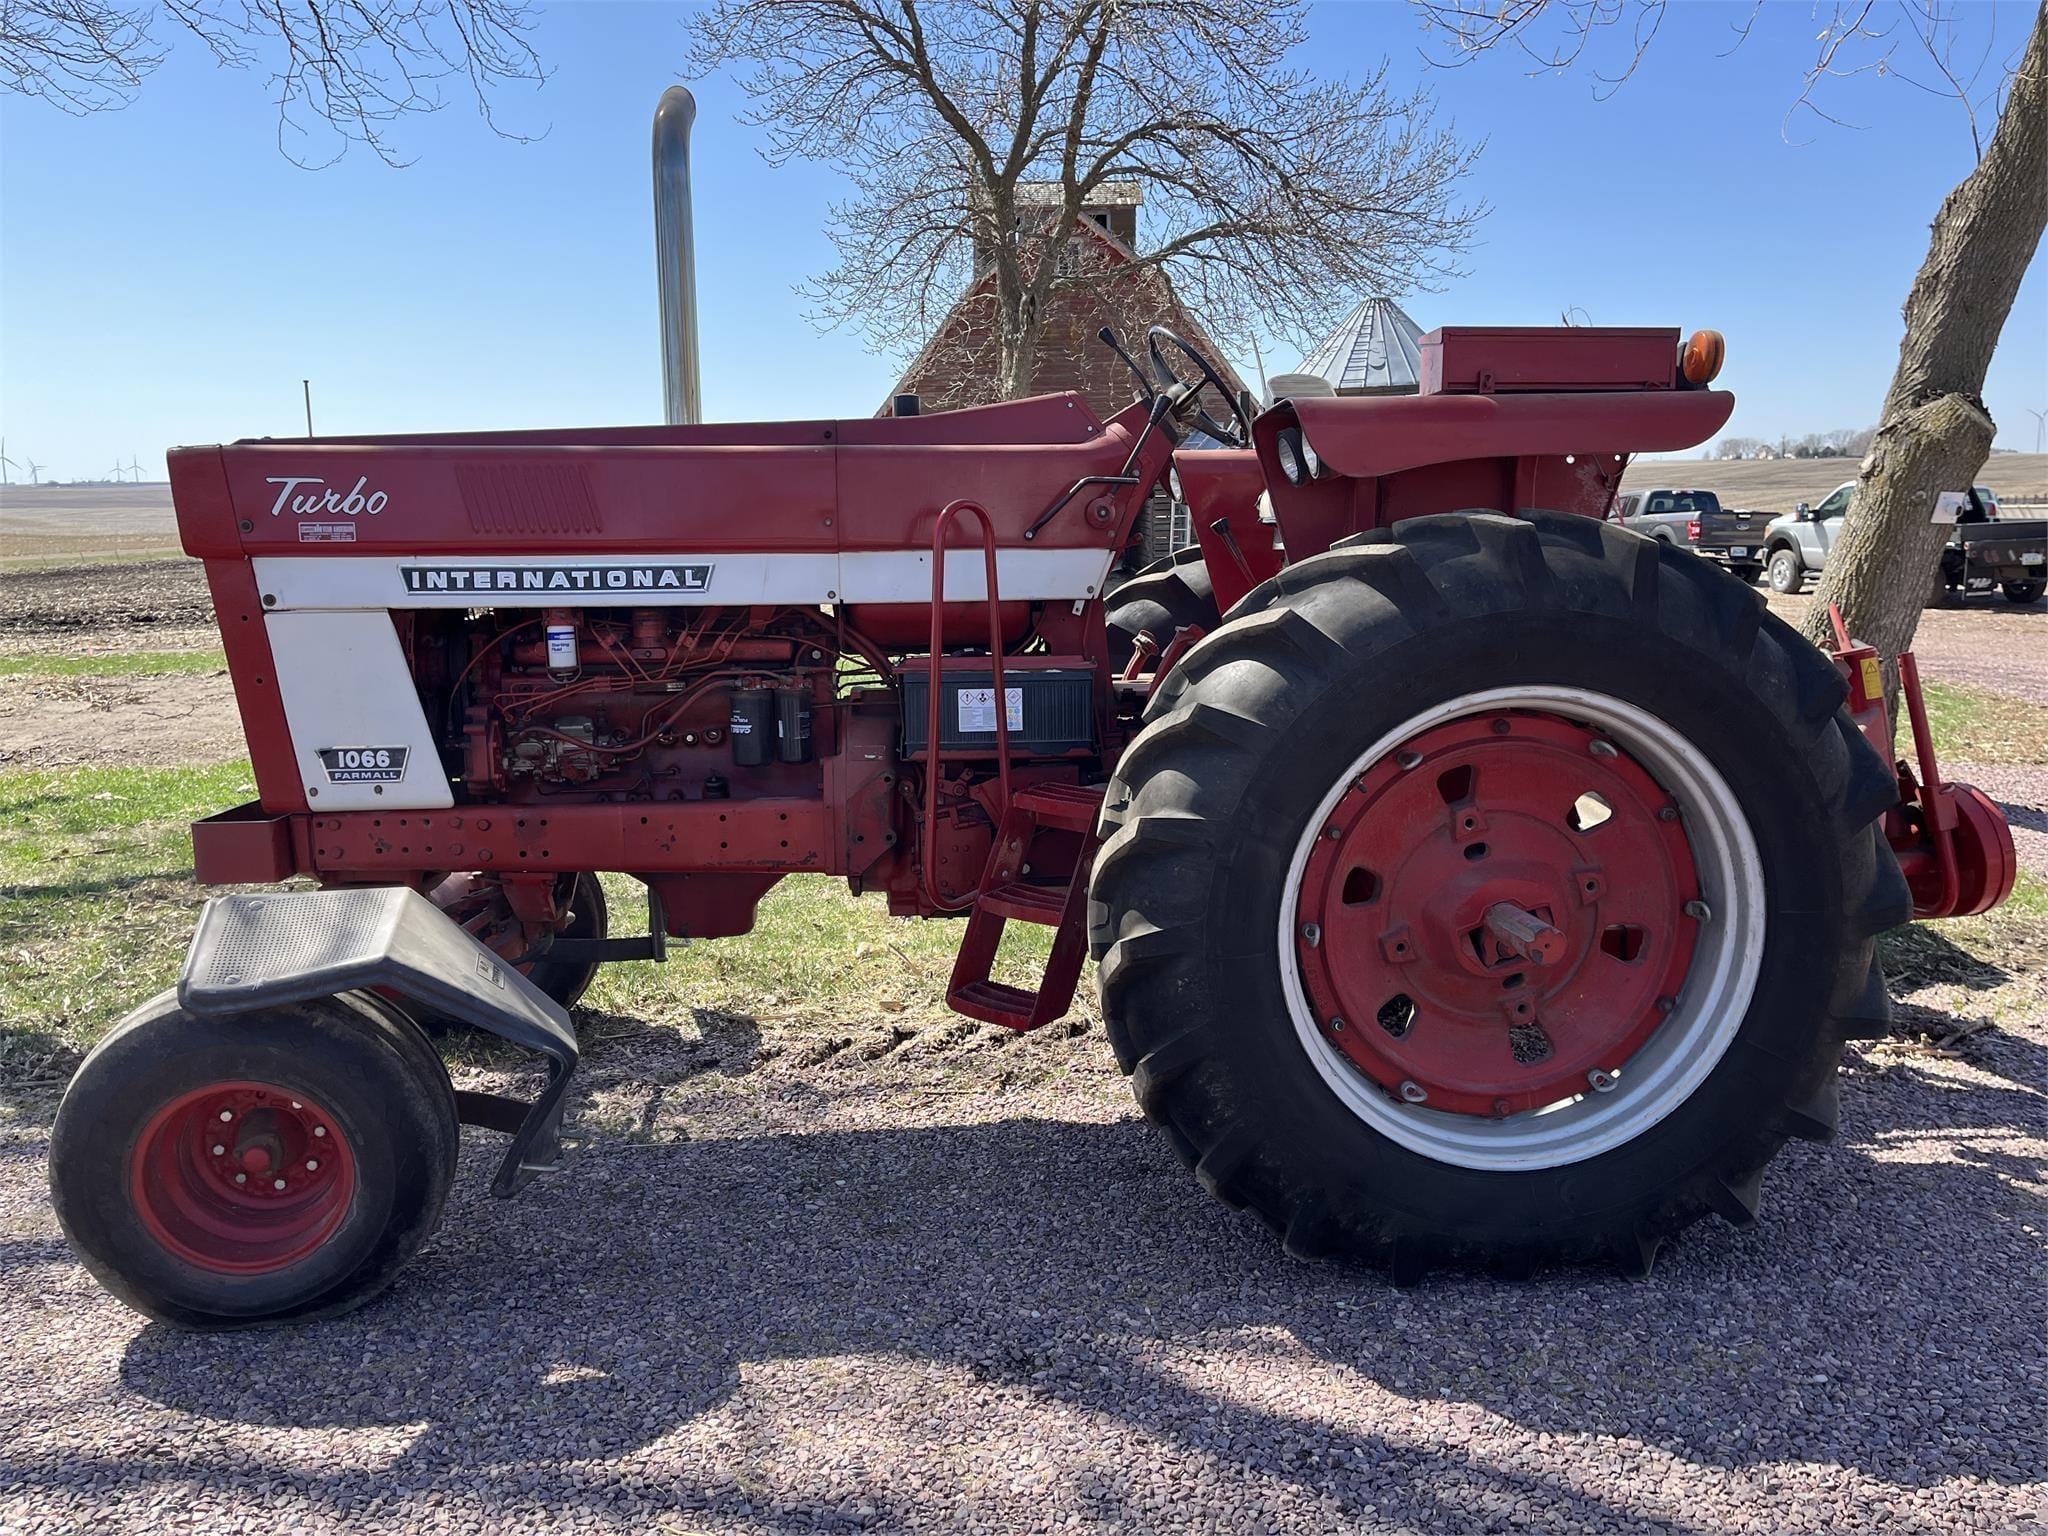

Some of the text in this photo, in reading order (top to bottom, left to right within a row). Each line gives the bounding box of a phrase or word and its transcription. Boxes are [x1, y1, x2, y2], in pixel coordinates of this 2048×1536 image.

[266, 475, 388, 516] Turbo
[411, 568, 702, 589] INTERNATIONAL
[338, 750, 391, 769] 1066
[334, 771, 397, 780] FARMALL
